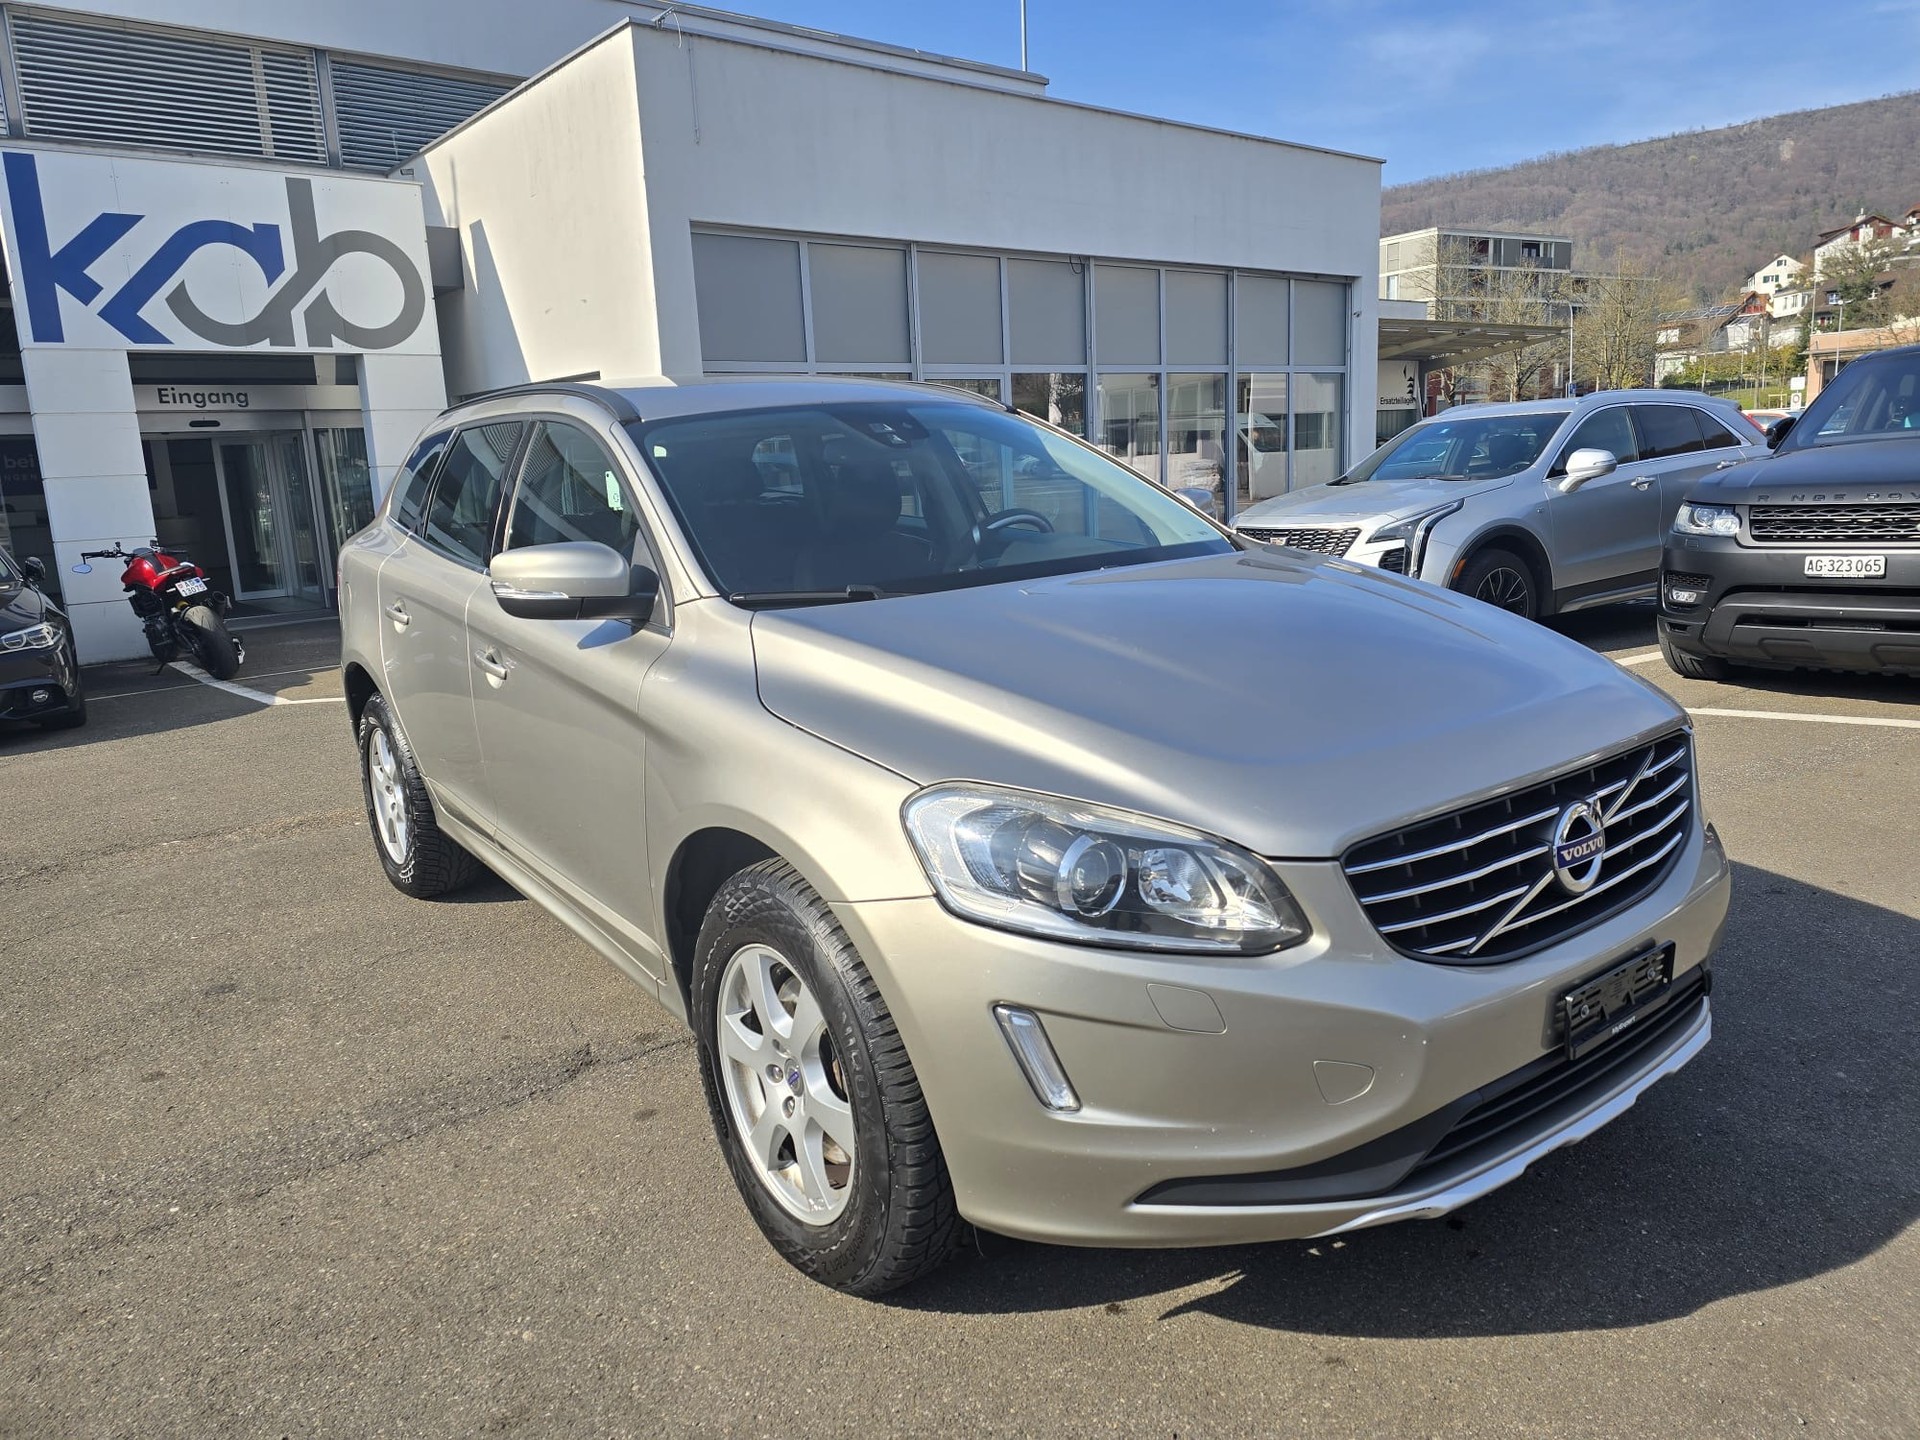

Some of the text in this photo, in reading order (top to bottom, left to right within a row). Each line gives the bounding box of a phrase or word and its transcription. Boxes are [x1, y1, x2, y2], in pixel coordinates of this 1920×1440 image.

[2, 151, 426, 350] kab
[157, 387, 250, 408] Eingang
[3, 454, 35, 469] bei
[1757, 494, 1846, 502] RNGE
[1855, 559, 1882, 572] 065
[1560, 834, 1604, 862] VOLVO
